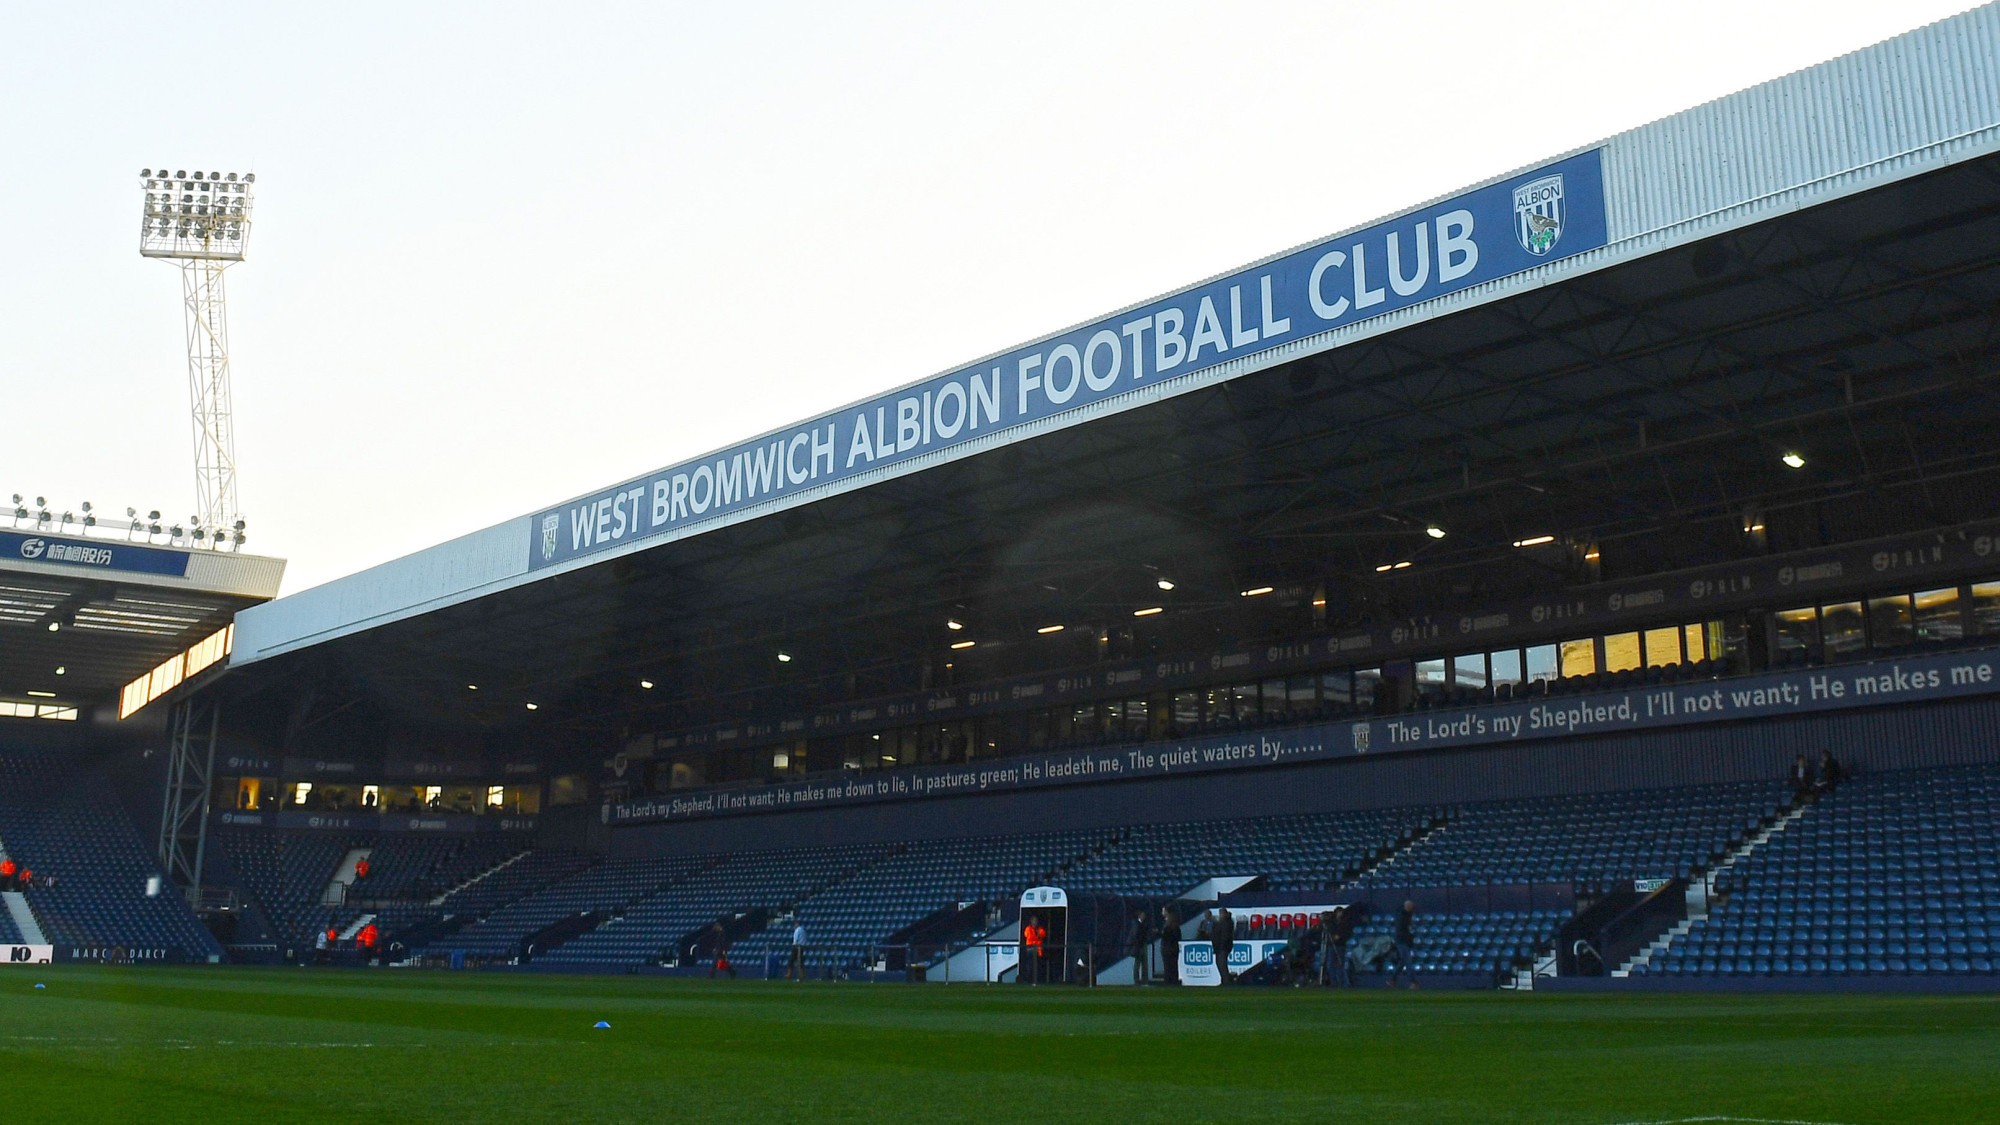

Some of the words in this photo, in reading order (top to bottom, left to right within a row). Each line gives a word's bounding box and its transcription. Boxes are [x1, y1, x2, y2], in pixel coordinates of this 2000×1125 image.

[1517, 184, 1560, 209] ALBION
[571, 487, 645, 549] WEST
[651, 424, 835, 527] BROMWICH
[846, 367, 1000, 467] ALBION
[1018, 277, 1290, 414] FOOTBALL
[1309, 210, 1478, 319] CLUB
[1387, 722, 1421, 743] The
[1428, 714, 1486, 739] Lord's
[1493, 715, 1522, 737] my
[1529, 697, 1638, 731] Shepherd,
[1647, 692, 1675, 717] I'll
[1684, 690, 1723, 713] not
[1731, 683, 1800, 706] want;
[1810, 676, 1845, 700] He
[1855, 666, 1940, 695] makes
[1951, 664, 1992, 685] me
[616, 805, 630, 818] The
[632, 802, 656, 817] Lord's
[657, 804, 670, 818] my
[672, 795, 715, 815] Shepherd,
[731, 795, 746, 808] not
[749, 793, 775, 807] want;
[777, 789, 791, 803] He
[793, 785, 824, 802] makes
[827, 787, 842, 799] me
[845, 781, 874, 797] down
[877, 780, 889, 794] to
[892, 776, 908, 793] lie,
[912, 775, 923, 790] In
[926, 773, 976, 794] pastures
[979, 768, 1018, 789] green;
[1023, 763, 1040, 780] He
[1045, 754, 1094, 777] leadeth
[1099, 758, 1123, 773] me,
[1128, 751, 1154, 769] The
[1159, 746, 1198, 771] quiet
[1203, 743, 1256, 762] waters
[72, 948, 107, 958] MARC
[130, 948, 166, 959] DARCY
[1186, 947, 1211, 962] ideal
[1228, 946, 1250, 962] deal
